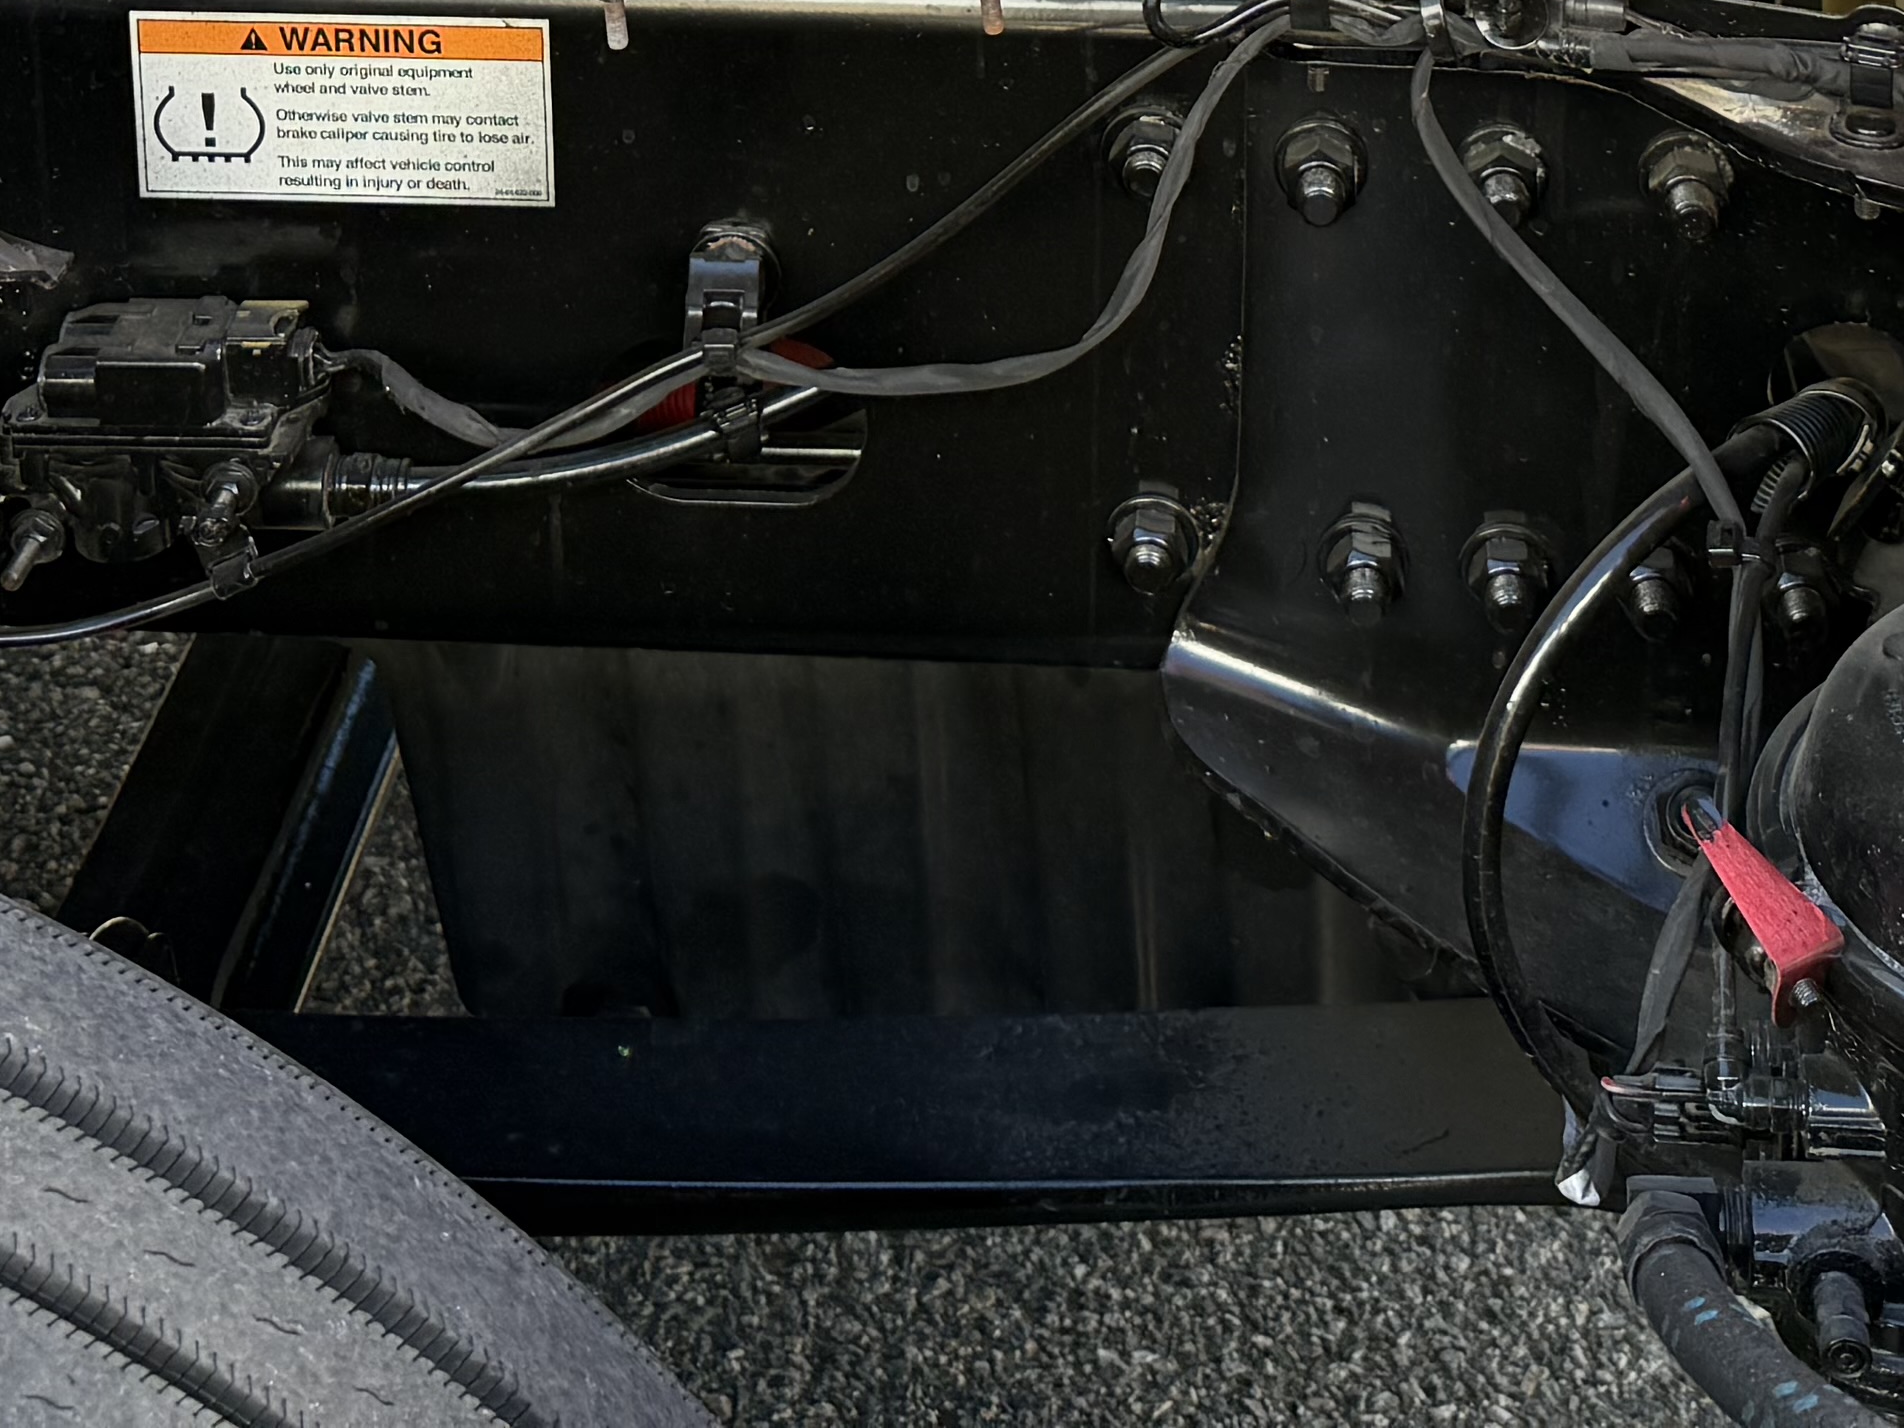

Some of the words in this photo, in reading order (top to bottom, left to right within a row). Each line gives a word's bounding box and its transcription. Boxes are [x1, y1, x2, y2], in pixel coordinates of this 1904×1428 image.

[278, 25, 443, 55] WARNING
[273, 62, 301, 76] Use
[305, 62, 335, 79] only
[340, 63, 393, 80] original
[397, 66, 474, 81] equipment
[274, 81, 315, 94] wheel
[319, 82, 346, 95] and
[350, 83, 388, 96] valve
[392, 85, 431, 97] stem.
[276, 108, 347, 122] Otherwise
[352, 111, 390, 124] valve
[393, 112, 428, 124] stem
[432, 114, 461, 128] may
[466, 114, 519, 127] contact
[277, 126, 317, 140] brake
[320, 128, 368, 143] caliper
[372, 130, 428, 145] causing
[433, 130, 456, 143] tire
[460, 131, 474, 144] to
[478, 131, 508, 144] lose
[512, 133, 535, 145] air.
[278, 155, 307, 169] This
[312, 158, 341, 171] may
[346, 157, 386, 171] affect
[390, 158, 440, 172] vehicle
[445, 160, 495, 173] control
[279, 175, 341, 190] resulting
[346, 175, 358, 188] in
[363, 176, 403, 191] injury
[407, 178, 422, 190] or
[426, 177, 470, 191] death.
